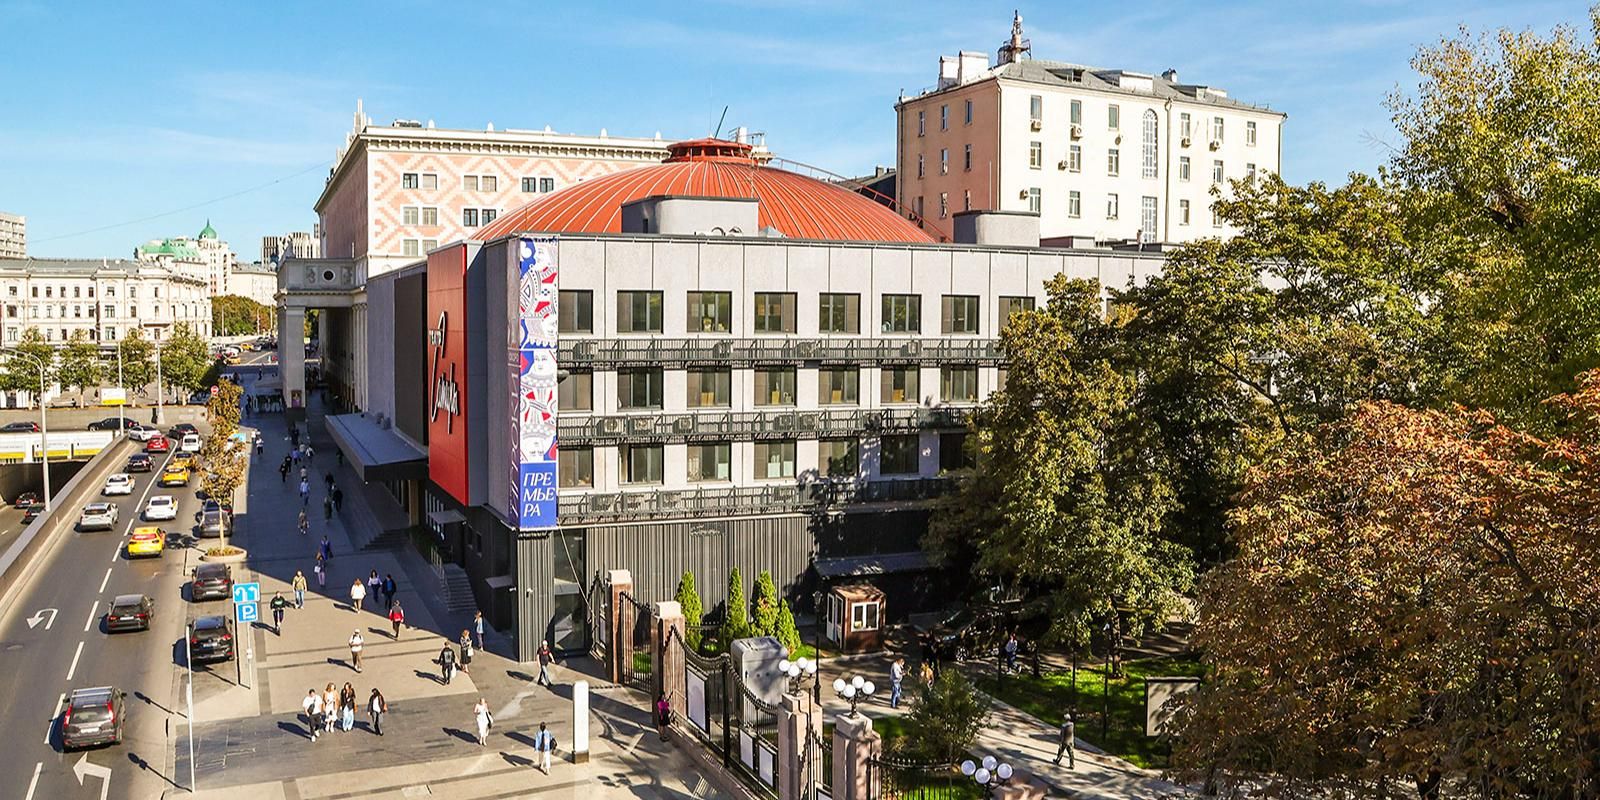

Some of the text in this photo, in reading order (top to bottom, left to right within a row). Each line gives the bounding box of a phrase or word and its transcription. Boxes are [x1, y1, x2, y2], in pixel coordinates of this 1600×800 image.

[523, 472, 553, 486] ПРЕ
[523, 487, 556, 502] МЬЕ
[523, 503, 541, 517] РА
[242, 605, 255, 620] P
